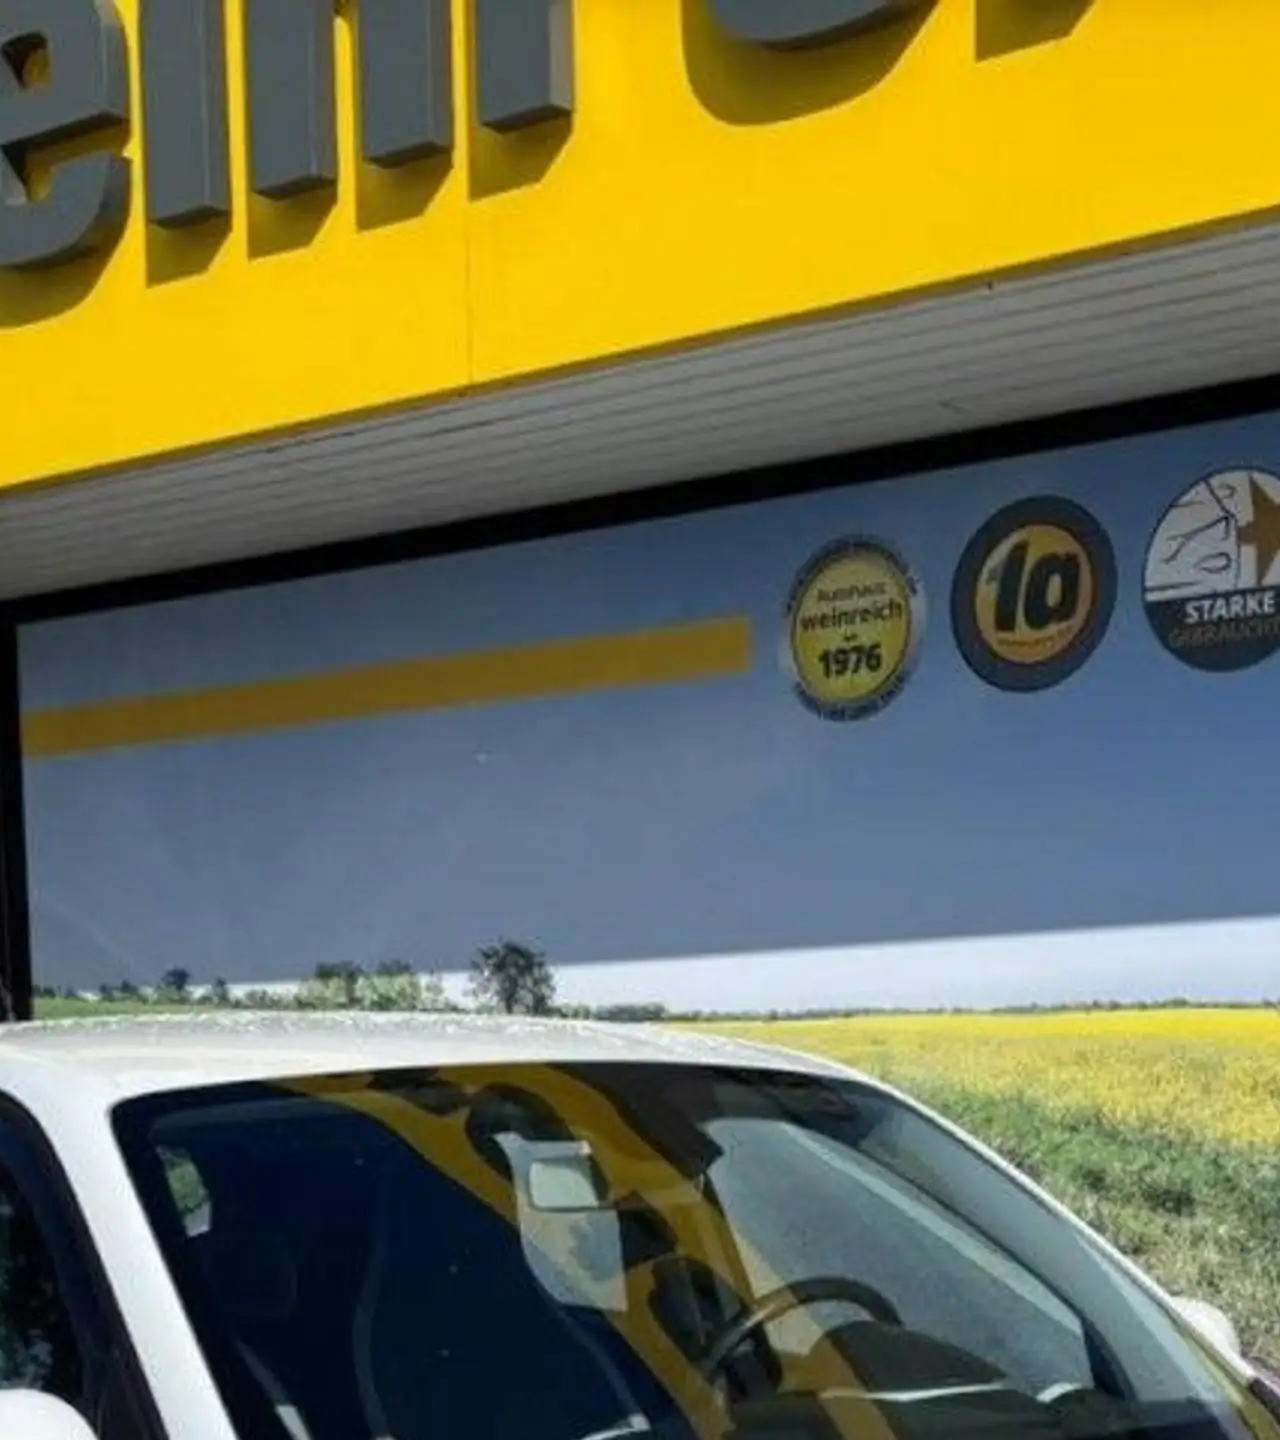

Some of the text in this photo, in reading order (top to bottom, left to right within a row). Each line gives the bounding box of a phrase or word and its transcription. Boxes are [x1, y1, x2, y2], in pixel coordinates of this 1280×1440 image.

[986, 540, 1081, 632] 1a
[1184, 590, 1277, 625] STARKE
[818, 642, 882, 679] 1976
